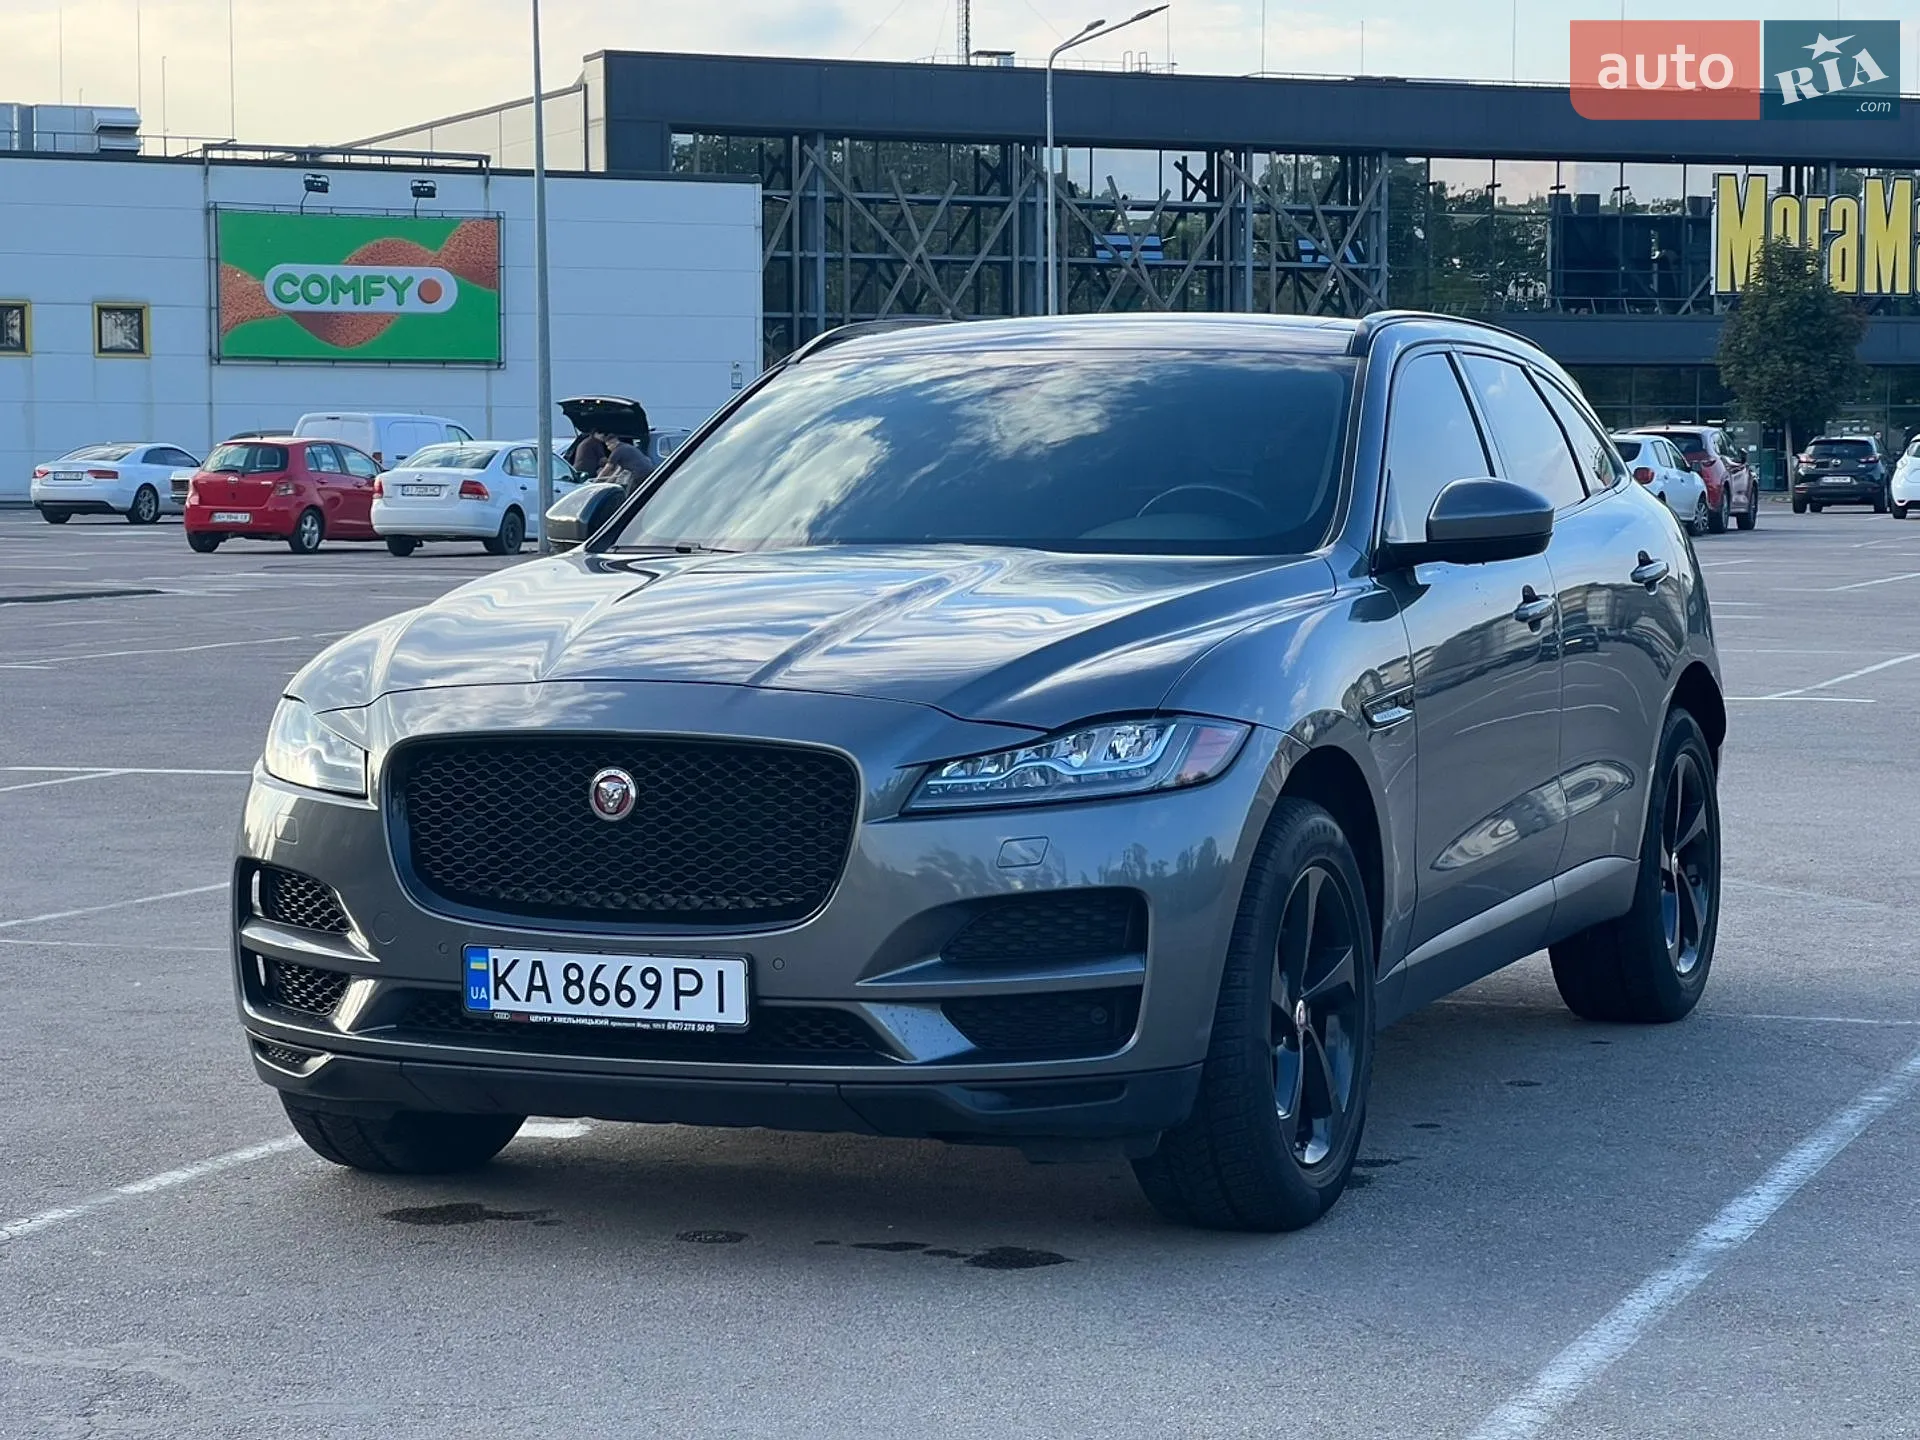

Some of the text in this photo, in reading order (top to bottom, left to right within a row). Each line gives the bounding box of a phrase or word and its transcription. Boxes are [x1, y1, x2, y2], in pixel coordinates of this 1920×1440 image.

[1716, 174, 1920, 295] МегаМ
[273, 273, 414, 306] COMFY
[470, 986, 488, 1001] UA
[492, 957, 725, 1014] KA 8669 PI
[529, 1014, 552, 1023] ЦЕНТР
[697, 1024, 705, 1032] 50
